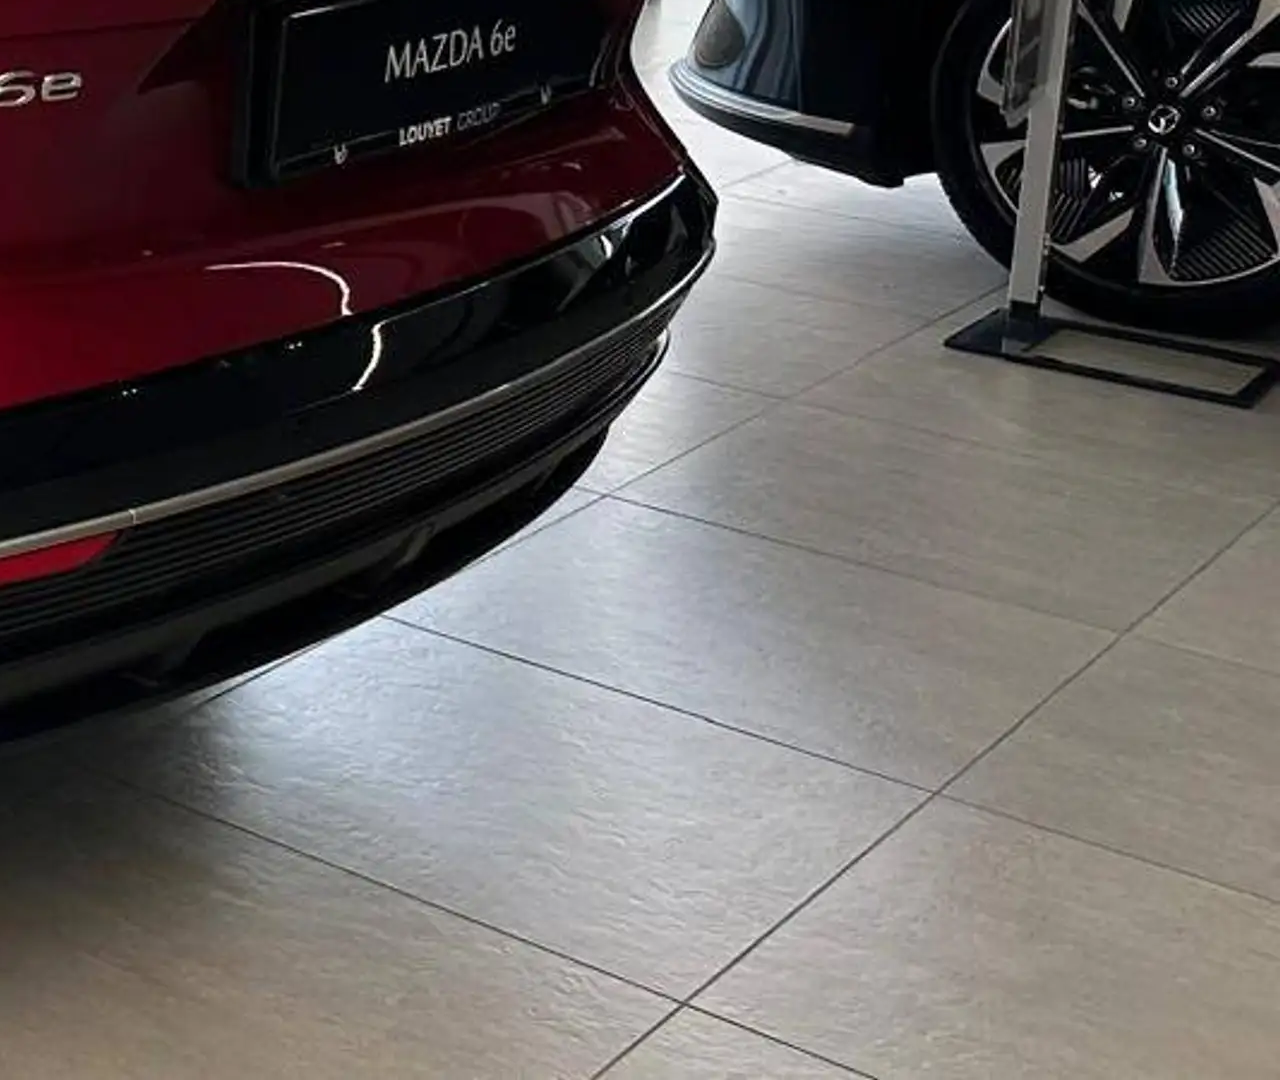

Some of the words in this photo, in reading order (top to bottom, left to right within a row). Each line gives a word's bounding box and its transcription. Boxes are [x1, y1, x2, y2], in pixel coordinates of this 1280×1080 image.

[384, 24, 485, 84] MAZDA
[489, 18, 517, 57] 6e
[397, 115, 453, 147] LOUYET
